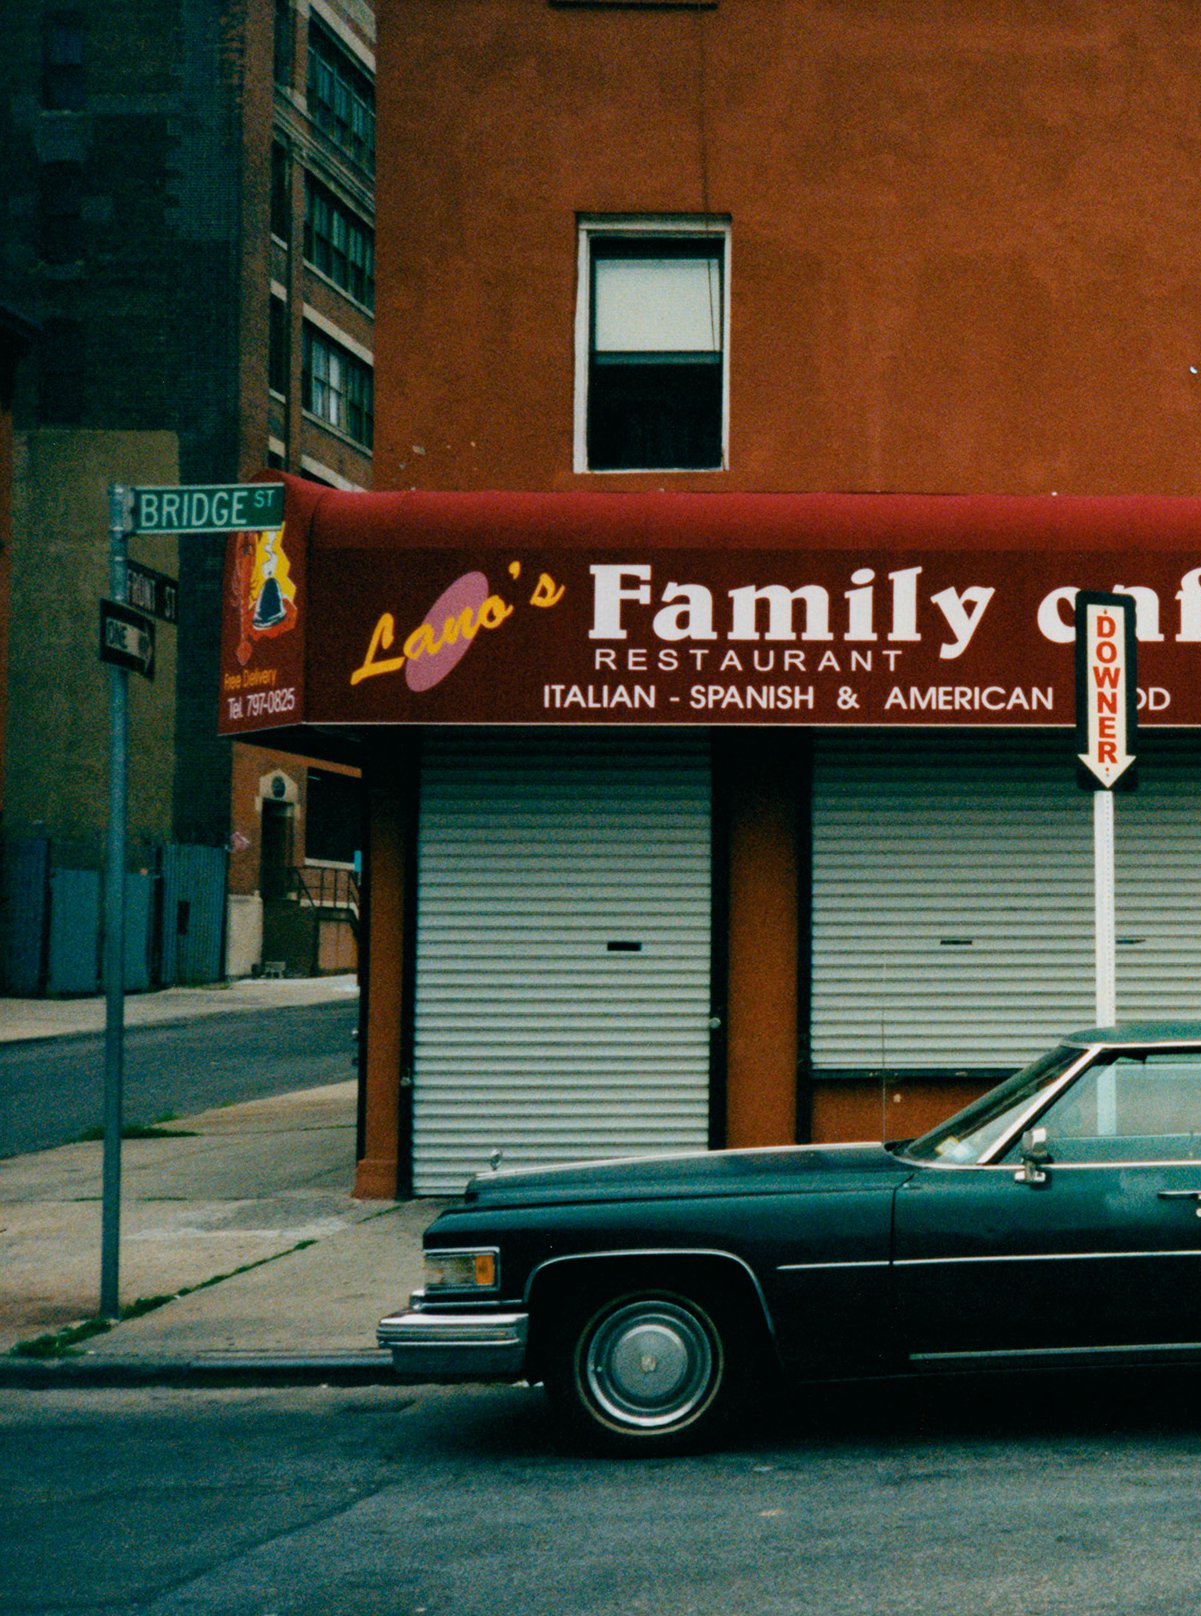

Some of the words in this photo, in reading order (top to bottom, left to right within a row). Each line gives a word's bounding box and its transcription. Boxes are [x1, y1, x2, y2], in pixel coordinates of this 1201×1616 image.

[141, 491, 249, 527] BRIDGE
[254, 490, 275, 508] ST
[350, 560, 566, 686] Lano's
[589, 564, 995, 659] Family
[595, 649, 902, 672] RESTAURANT
[224, 673, 241, 690] Free
[243, 668, 277, 688] Delivery
[1092, 615, 1122, 764] DOWNER
[246, 687, 295, 717] 797-0825
[543, 685, 655, 708] ITALIAN
[689, 685, 814, 709] SPANISH
[837, 686, 859, 710] &
[884, 686, 1053, 710] AMERICAN
